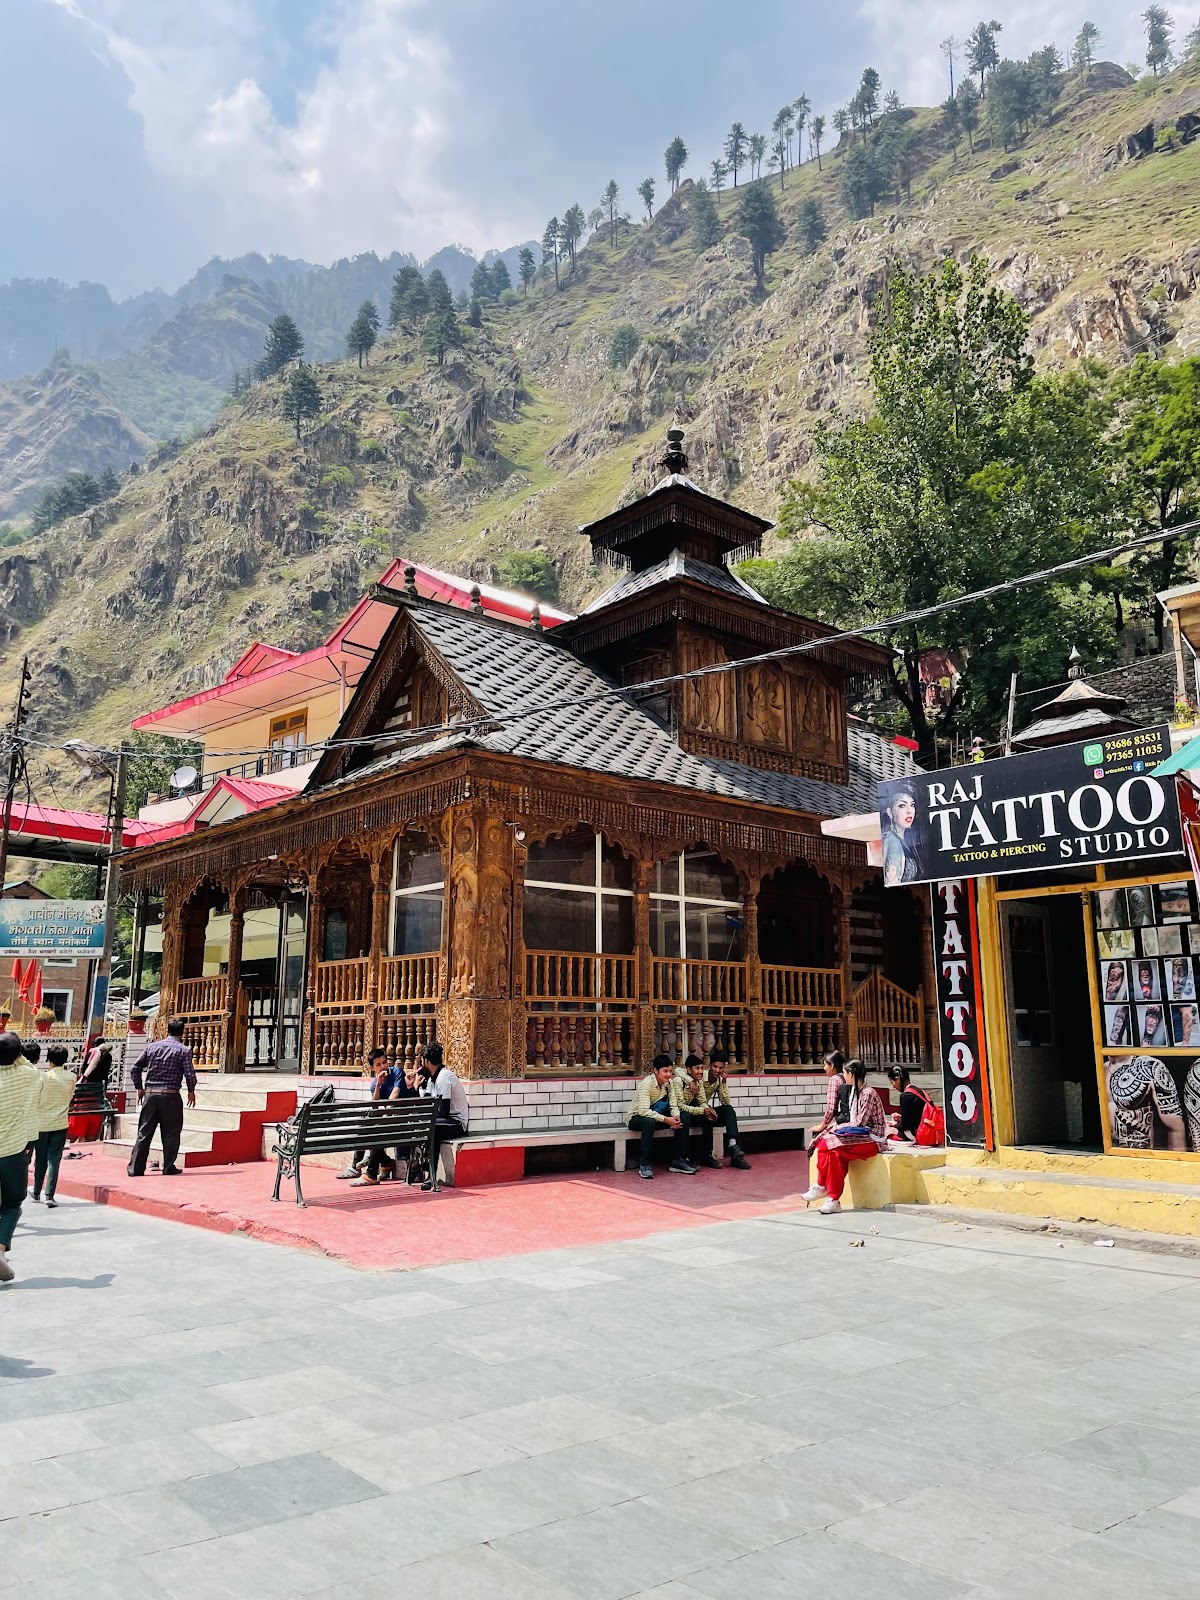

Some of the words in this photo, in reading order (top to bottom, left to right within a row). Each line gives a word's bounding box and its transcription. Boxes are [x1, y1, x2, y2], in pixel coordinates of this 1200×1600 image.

[1105, 738, 1132, 751] 93686
[1134, 732, 1162, 745] 83531
[1106, 750, 1133, 762] 97365
[1136, 744, 1163, 757] 11035
[927, 774, 984, 807] RAJ
[929, 776, 1165, 852] TATTOO
[1059, 826, 1170, 858] STUDIO
[953, 850, 989, 862] TATTOO
[990, 849, 998, 858] &
[1000, 843, 1047, 857] PIERCING
[57, 906, 84, 921] मन्दिर
[9, 924, 47, 935] भगवती
[49, 922, 68, 935] नैना
[71, 925, 94, 935] माता
[938, 880, 978, 1122] TATTOO
